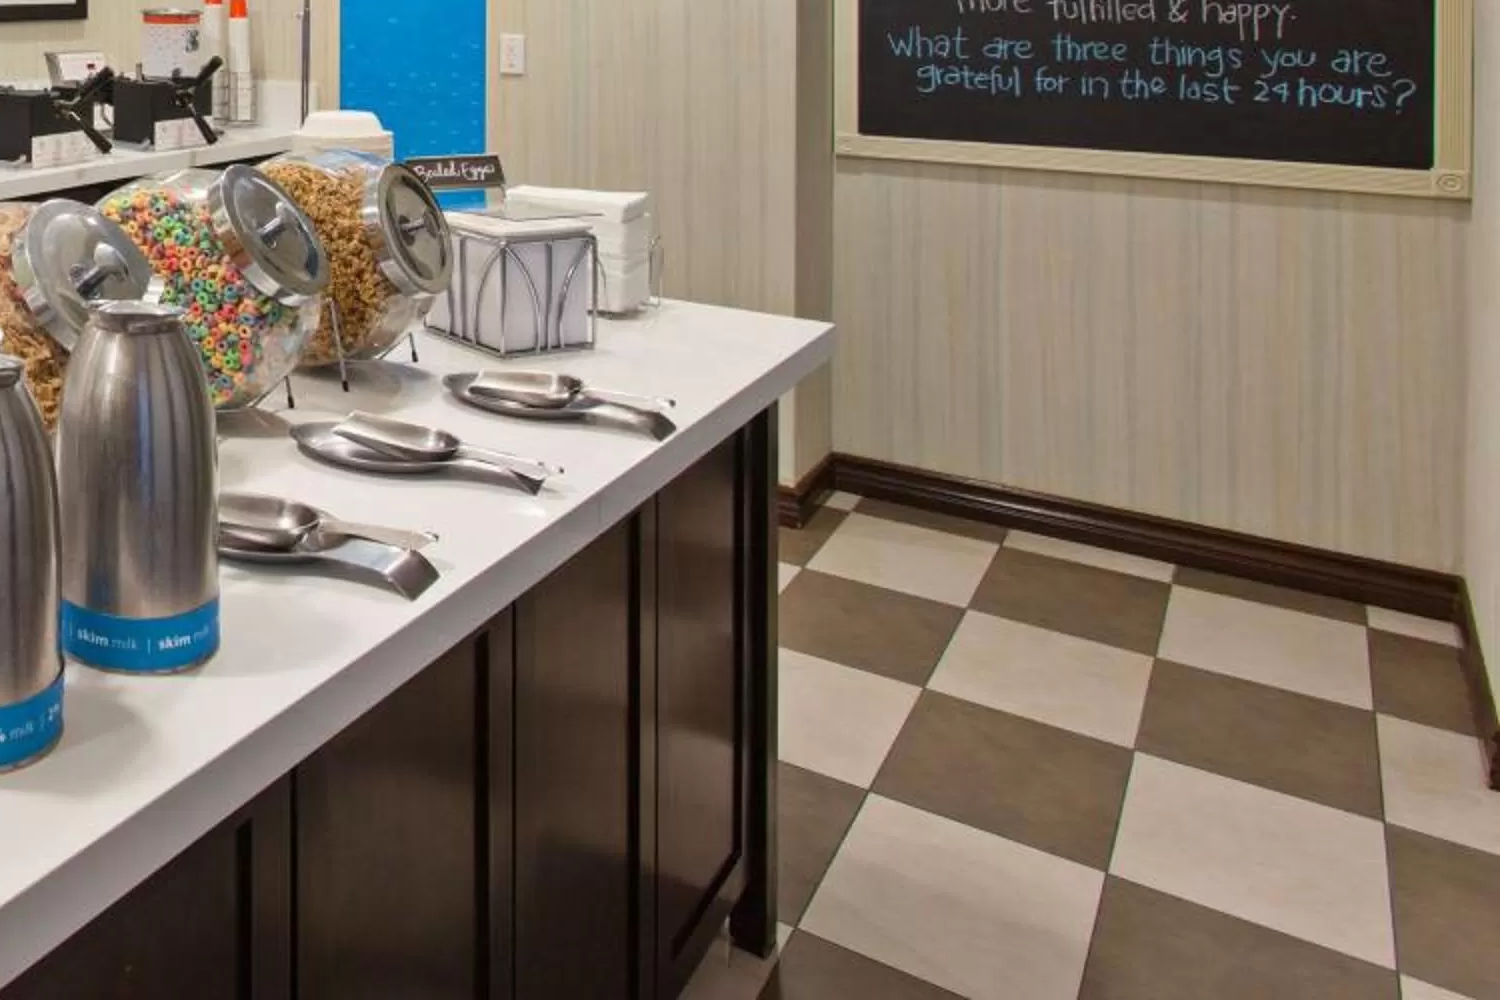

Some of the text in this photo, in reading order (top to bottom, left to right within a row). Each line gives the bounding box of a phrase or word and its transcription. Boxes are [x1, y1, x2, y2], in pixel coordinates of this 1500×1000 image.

[982, 37, 1034, 60] are
[1051, 31, 1129, 63] three
[1149, 35, 1243, 78] things
[1260, 49, 1318, 79] you
[1331, 49, 1393, 78] are
[916, 63, 1022, 97] grateful
[1035, 65, 1071, 94] for
[1080, 75, 1109, 99] in
[1120, 68, 1168, 100] the
[1179, 73, 1242, 105] last
[77, 627, 109, 648] skim
[157, 633, 191, 651] skim
